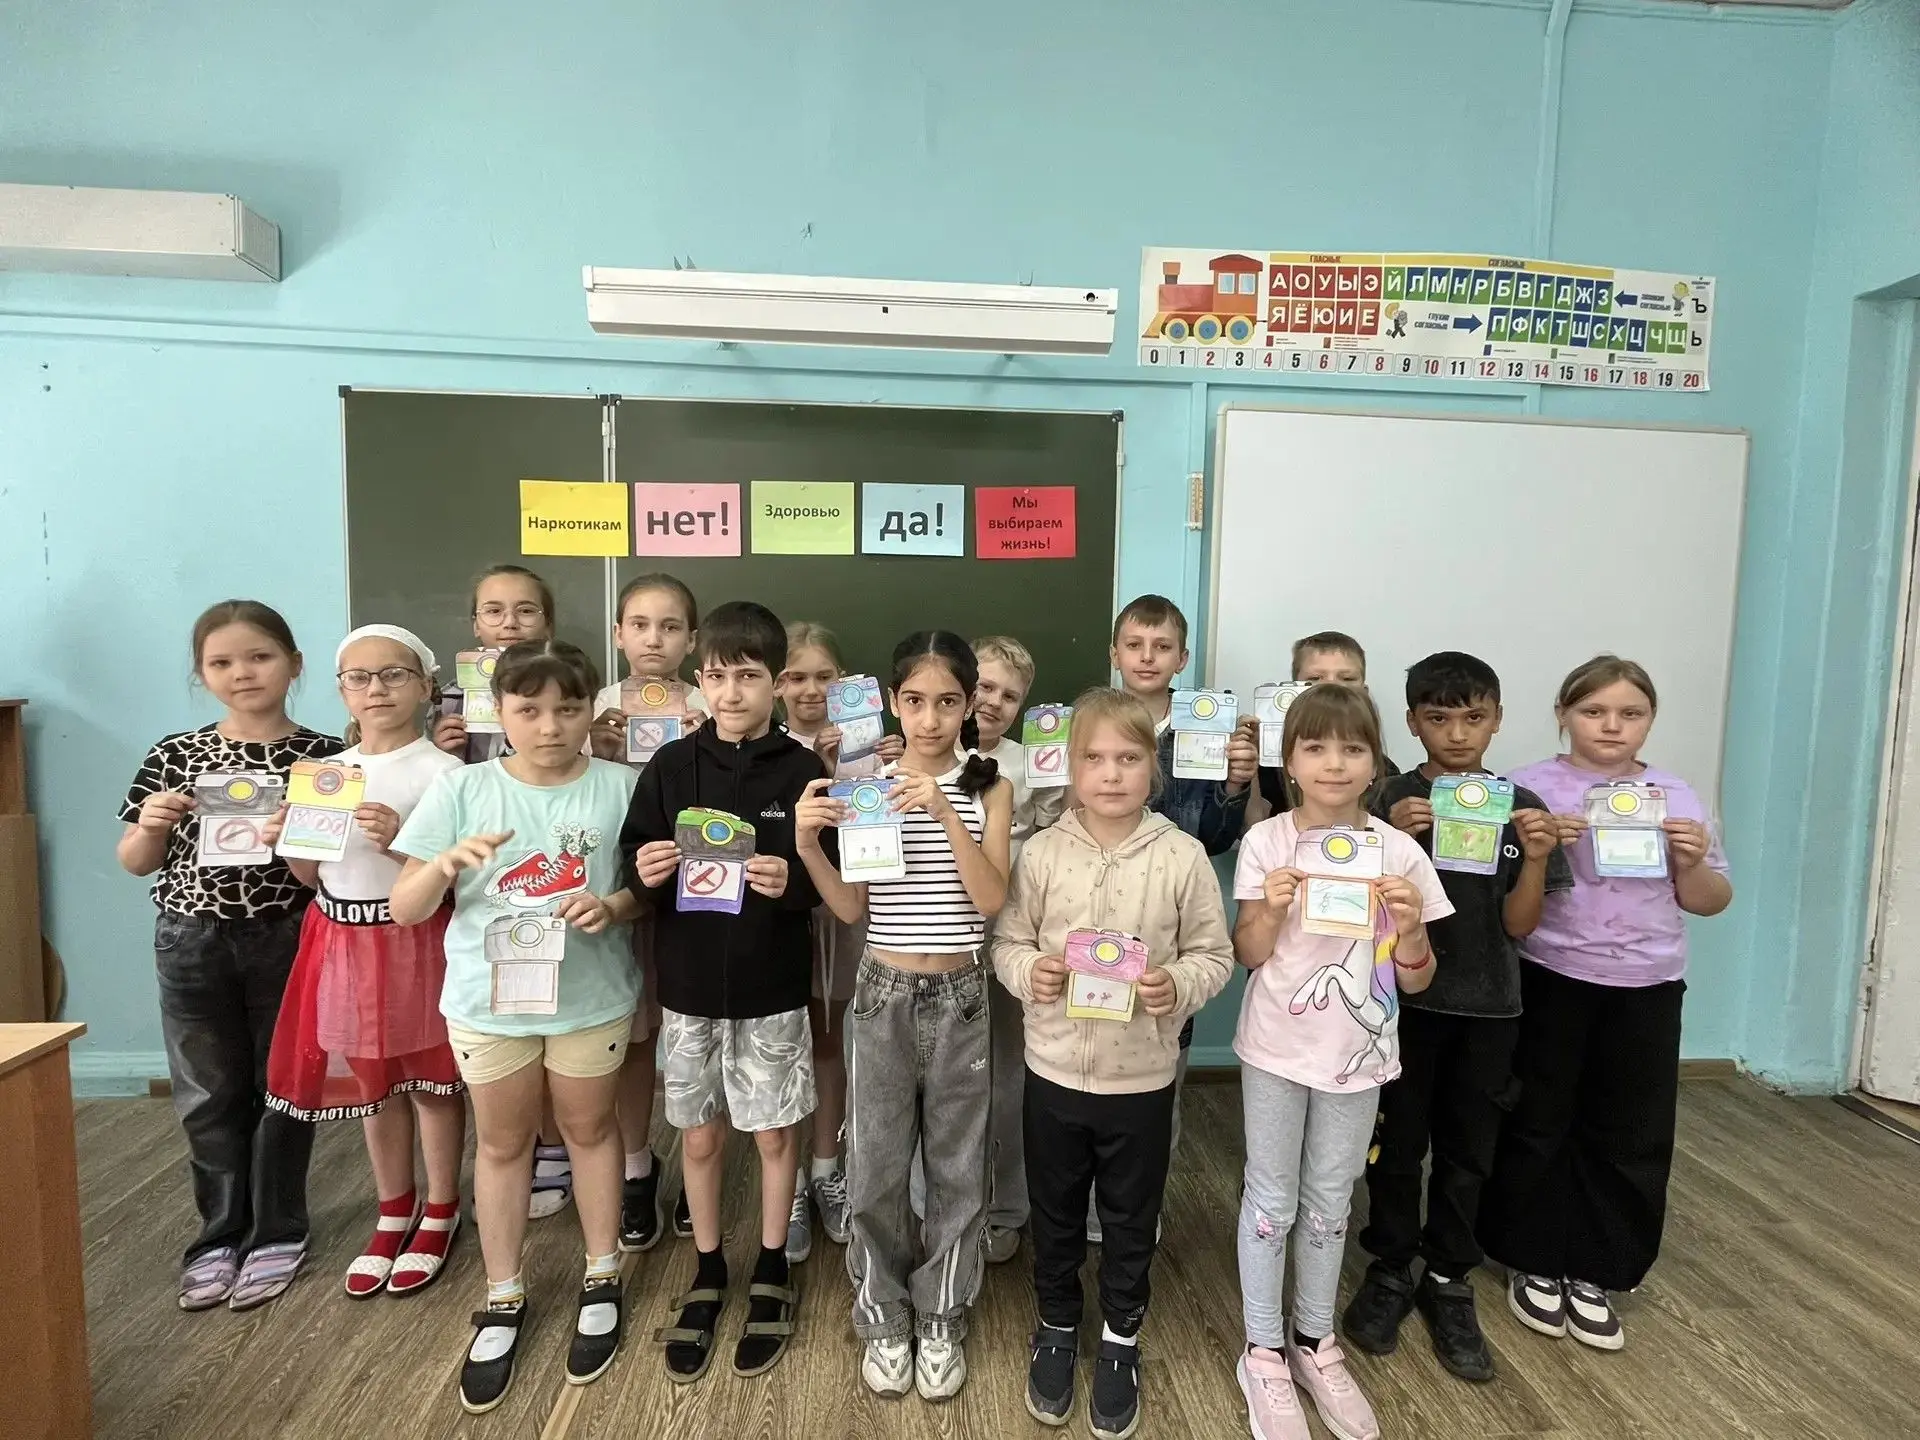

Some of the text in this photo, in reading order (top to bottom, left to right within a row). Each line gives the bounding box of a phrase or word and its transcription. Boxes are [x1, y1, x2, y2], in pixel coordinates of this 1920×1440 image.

[1271, 272, 1379, 292] А О У Ы Э
[1387, 270, 1609, 306] Й Л М Н Р Б В Г Д Ж З
[1271, 303, 1376, 327] Я Ё Ю И Е
[1491, 315, 1686, 349] П Ф К Т Ш С Х Ц Ч Щ
[1150, 349, 1700, 388] 0 1 2 3 4 5 6 7 8 9 10 11 12 13 14 15 16 17 18 19 20
[764, 504, 841, 520] Здоровью
[1011, 496, 1038, 509] Мы
[527, 515, 622, 532] Наркотикам
[646, 501, 729, 536] нет!
[879, 502, 944, 543] да!
[988, 517, 1063, 532] выбираем
[1000, 537, 1051, 551] жизнь!
[760, 810, 786, 818] adidas
[335, 902, 392, 923] LOVE
[289, 1104, 311, 1122] LOVE
[345, 1104, 375, 1119] LOVE
